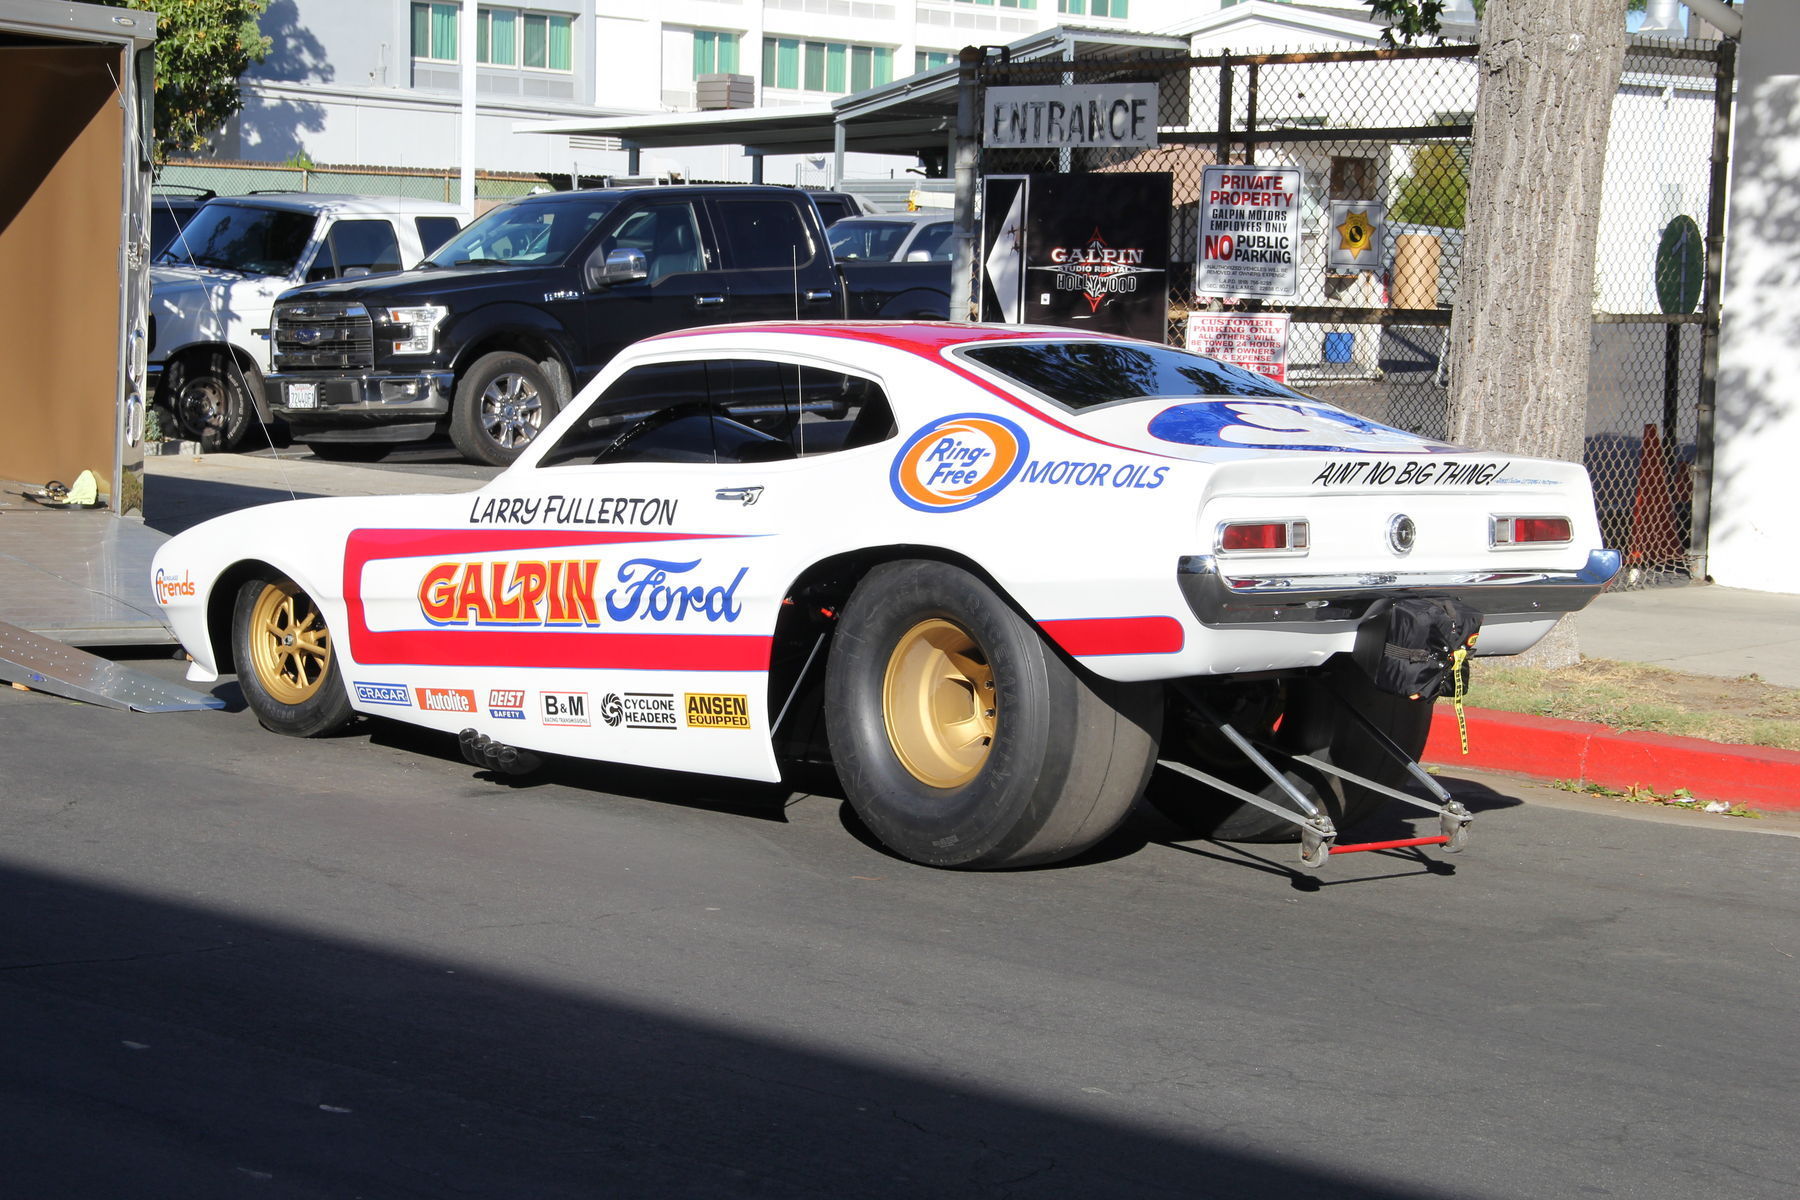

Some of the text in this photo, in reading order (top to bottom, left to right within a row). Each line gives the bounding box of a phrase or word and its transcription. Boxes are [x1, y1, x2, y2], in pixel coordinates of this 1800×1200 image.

[992, 98, 1148, 145] ENTRANCE
[1221, 174, 1284, 190] PRIVATE
[1210, 191, 1293, 207] PROPERTY
[1212, 208, 1287, 221] GALPIN MOTORS
[1210, 220, 1288, 233] EMPLOYEES ONLY
[1204, 235, 1234, 261] NO
[1236, 235, 1289, 249] PUBLIC
[1050, 246, 1144, 265] GALPIN
[1234, 248, 1291, 264] PARKING
[1058, 265, 1137, 273] STUDIO RENTALS
[1056, 273, 1137, 293] HOLLYWOOD
[1201, 319, 1273, 327] CUSTOMER
[1231, 354, 1272, 362] EXPENSE
[1237, 347, 1276, 355] OWNERS
[925, 437, 991, 467] Ring-
[926, 462, 978, 486] Free
[1020, 460, 1171, 489] MOTOR OILS
[1362, 461, 1396, 486] NO
[1394, 461, 1437, 486] BIG
[1434, 461, 1511, 487] THING!
[469, 495, 679, 526] LARRY FULLERTON
[417, 557, 750, 628] GALPIN Ford
[358, 687, 406, 701] CRAGAR
[425, 689, 470, 712] Autolite
[490, 691, 524, 707] DEIST
[623, 698, 675, 711] CYCLONE
[687, 696, 747, 716] ANSEN
[494, 710, 520, 718] SAFETY
[625, 712, 677, 724] HEADERS
[688, 715, 748, 726] EQUIPPED
